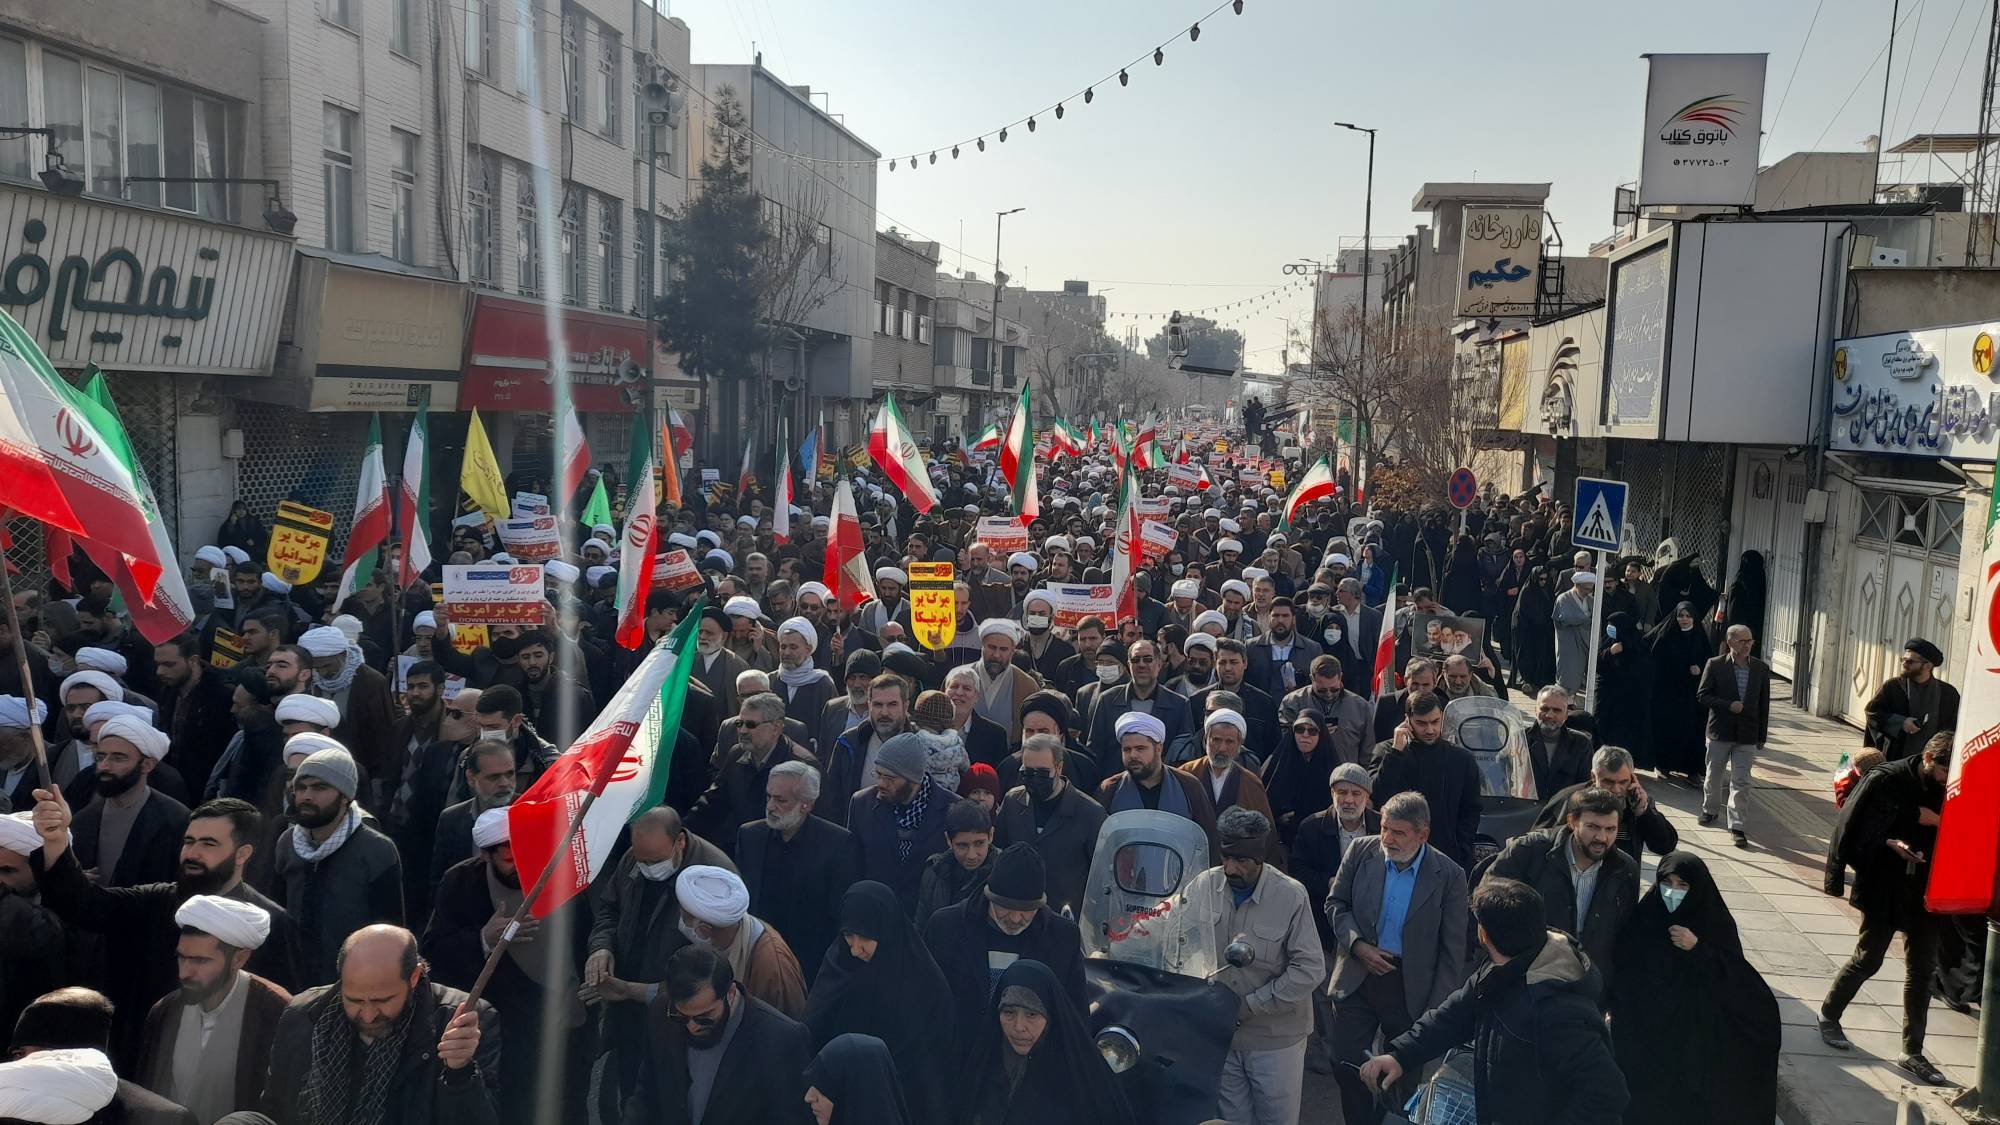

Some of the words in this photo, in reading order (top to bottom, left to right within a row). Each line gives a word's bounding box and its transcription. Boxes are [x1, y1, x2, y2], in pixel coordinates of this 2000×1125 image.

[1661, 129, 1692, 145] کتاب
[1693, 129, 1728, 146] پاتوق
[1682, 158, 1730, 167] ۳۷۷۳۵۰۰۳
[1467, 214, 1540, 249] داروخانه
[1468, 257, 1532, 290] حکیم
[494, 606, 505, 617] بر
